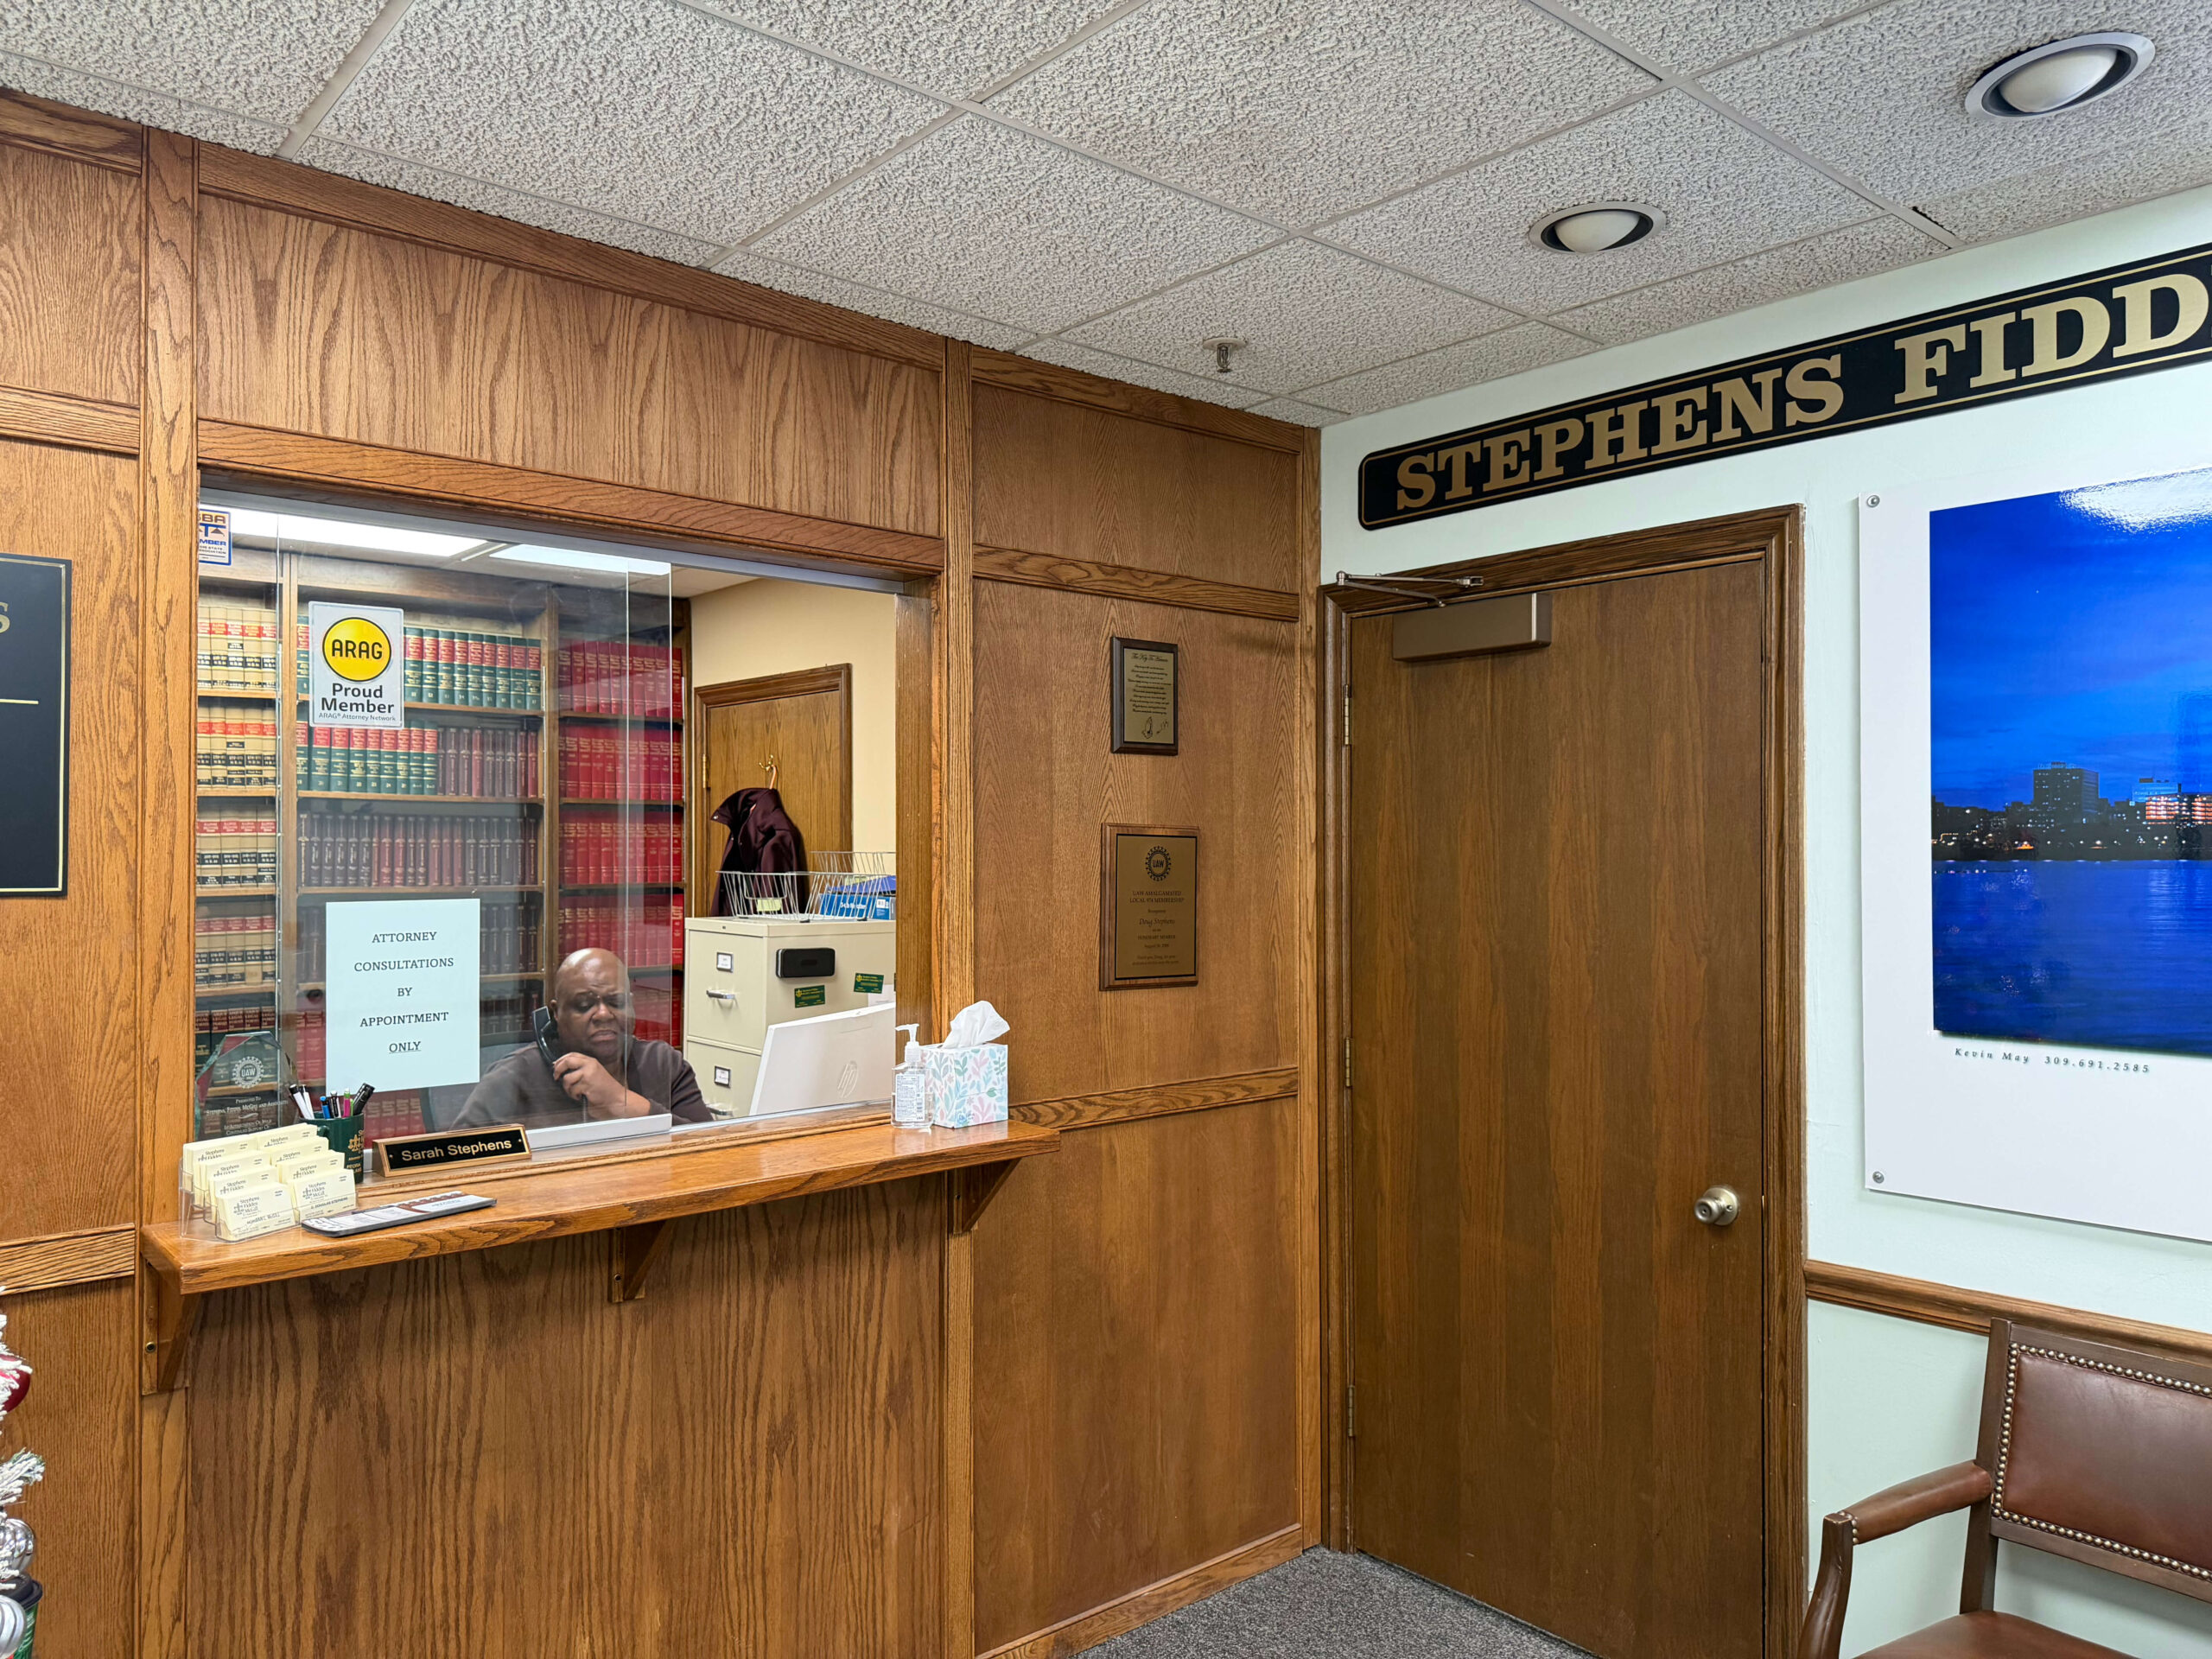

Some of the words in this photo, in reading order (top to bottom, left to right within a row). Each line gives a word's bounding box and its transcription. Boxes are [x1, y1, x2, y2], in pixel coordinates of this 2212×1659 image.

[1396, 353, 1844, 511] STEPHENS
[1895, 266, 2212, 404] FIDD
[332, 639, 383, 660] ARAG
[333, 683, 383, 698] Proud
[321, 697, 394, 714] Member
[1152, 859, 1164, 868] UAW
[372, 931, 437, 944] ATTORNEY
[353, 957, 454, 972] CONSULTATIONS
[397, 987, 413, 997] BY
[359, 1012, 449, 1027] APPOINTMENT
[389, 1041, 422, 1053] ONLY
[1955, 1047, 1993, 1059] Kevin
[2002, 1052, 2029, 1064] May
[2044, 1056, 2150, 1073] 309.691.2585
[402, 1147, 445, 1161] Sarah
[447, 1140, 512, 1156] Stephens
